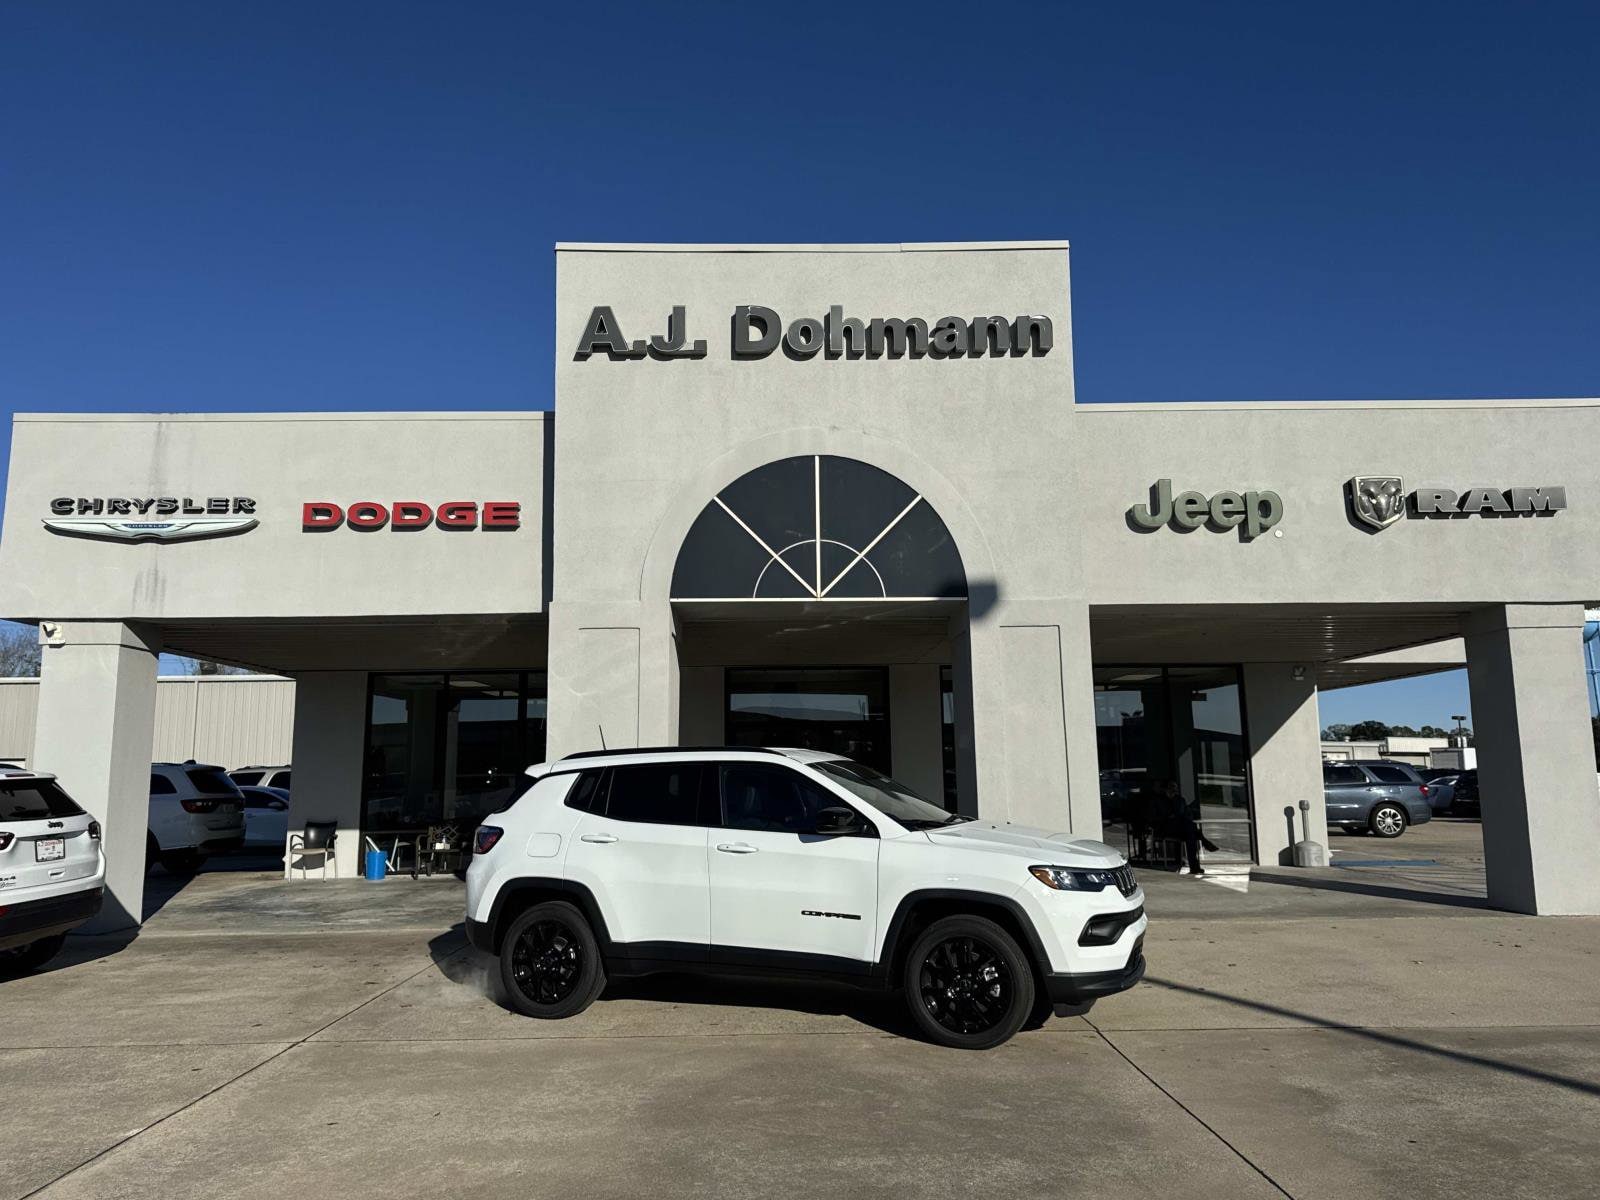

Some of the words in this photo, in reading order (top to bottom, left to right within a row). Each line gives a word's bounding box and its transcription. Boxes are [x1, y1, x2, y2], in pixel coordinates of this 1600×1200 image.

[574, 305, 708, 361] A.J.
[730, 304, 1054, 361] Dohmann
[50, 496, 257, 516] CHRYSLER
[302, 501, 520, 533] DODGE
[1126, 478, 1283, 543] Jeep
[1406, 486, 1567, 519] RAM
